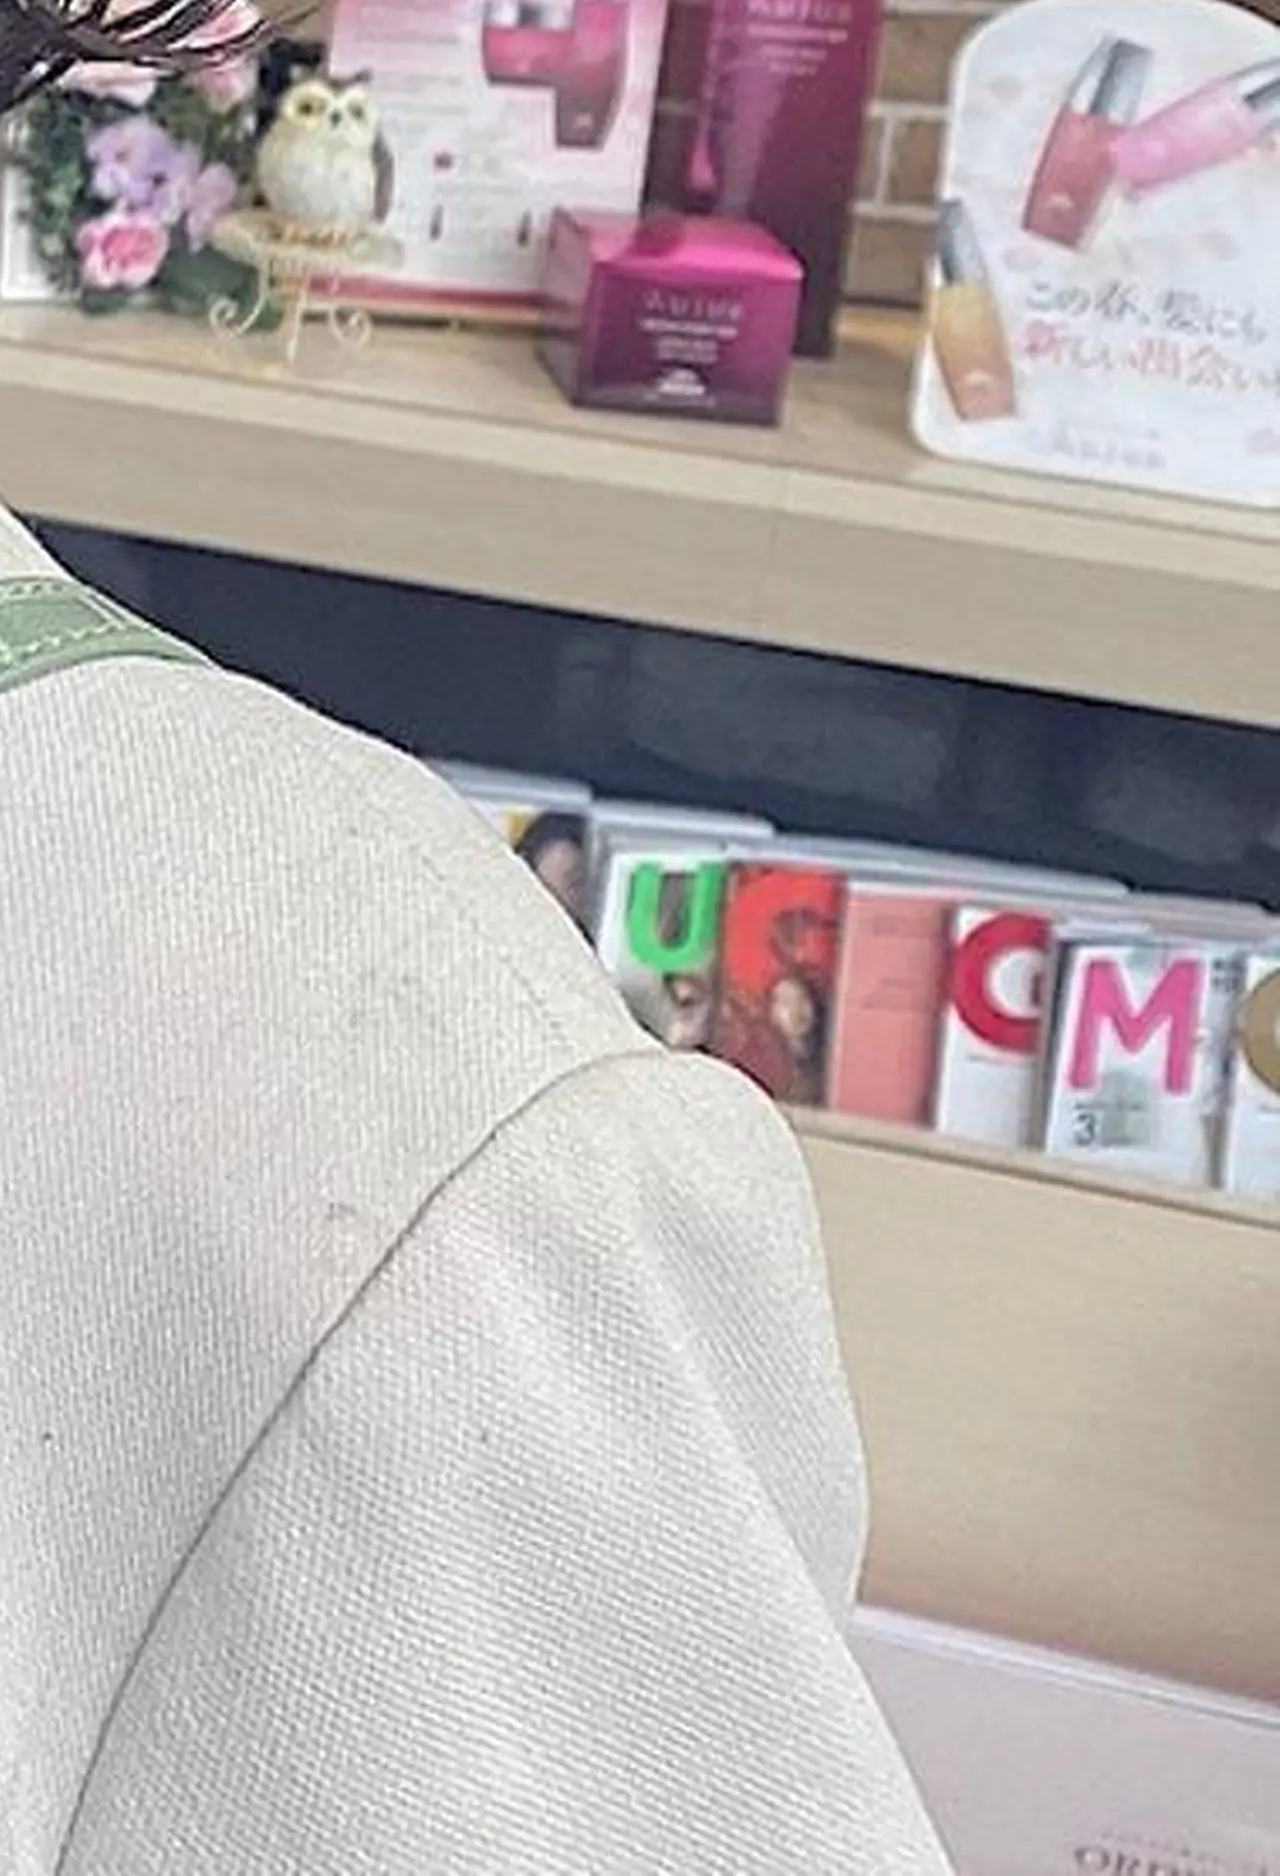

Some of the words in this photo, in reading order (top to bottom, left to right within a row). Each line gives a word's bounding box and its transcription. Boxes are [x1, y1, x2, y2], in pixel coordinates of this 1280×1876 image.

[1022, 319, 1280, 394] 新しい出会い
[1068, 957, 1206, 1096] M
